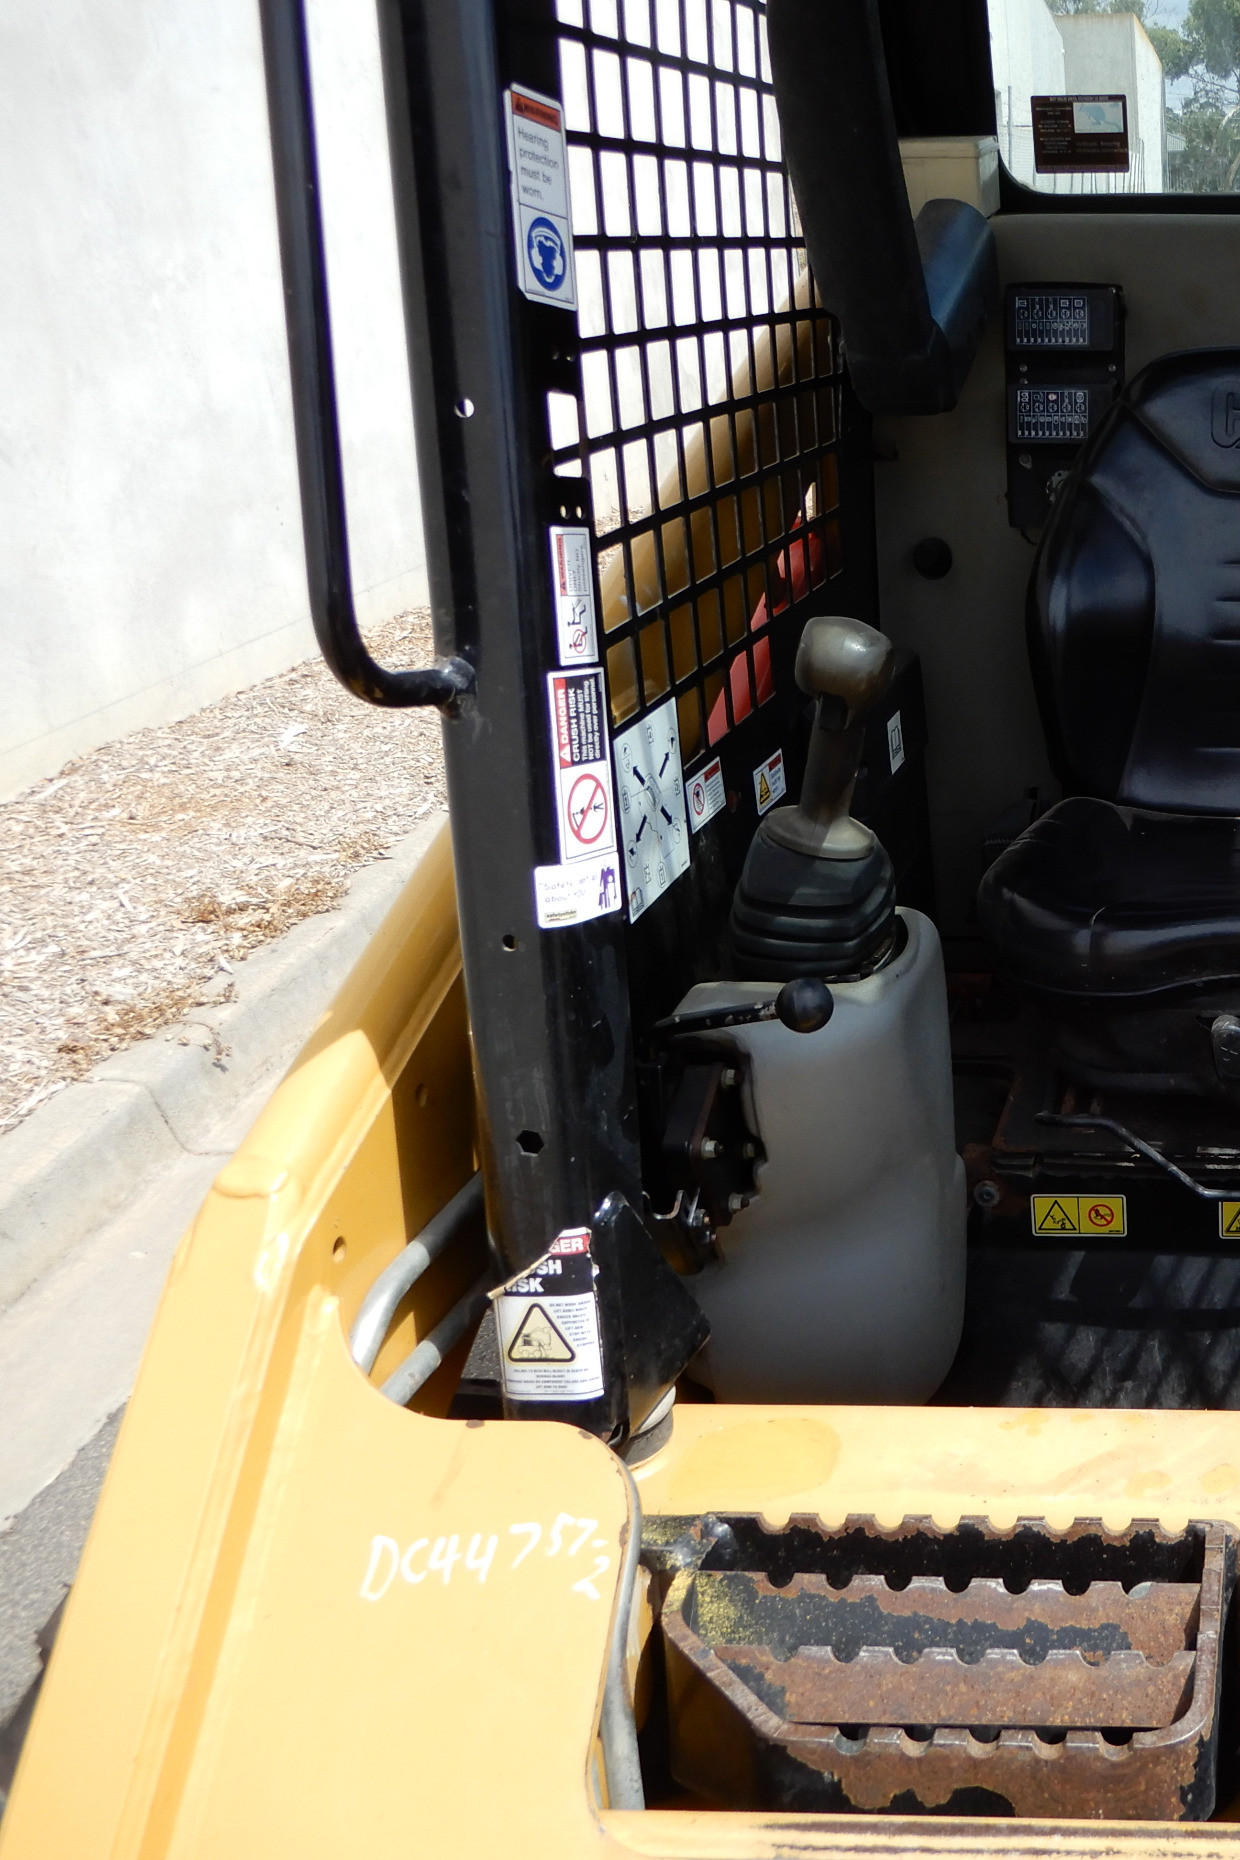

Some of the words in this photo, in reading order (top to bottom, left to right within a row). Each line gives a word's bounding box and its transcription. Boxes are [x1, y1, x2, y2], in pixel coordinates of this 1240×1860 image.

[517, 126, 549, 151] Hearing
[518, 147, 560, 170] protection
[520, 167, 541, 183] must
[542, 171, 552, 186] be
[568, 687, 577, 717] RISK
[576, 689, 584, 712] MUST
[557, 688, 569, 745] DANGER
[579, 712, 587, 745] machine
[570, 718, 580, 762] CRUSH
[587, 732, 594, 743] be
[550, 1237, 584, 1253] GER
